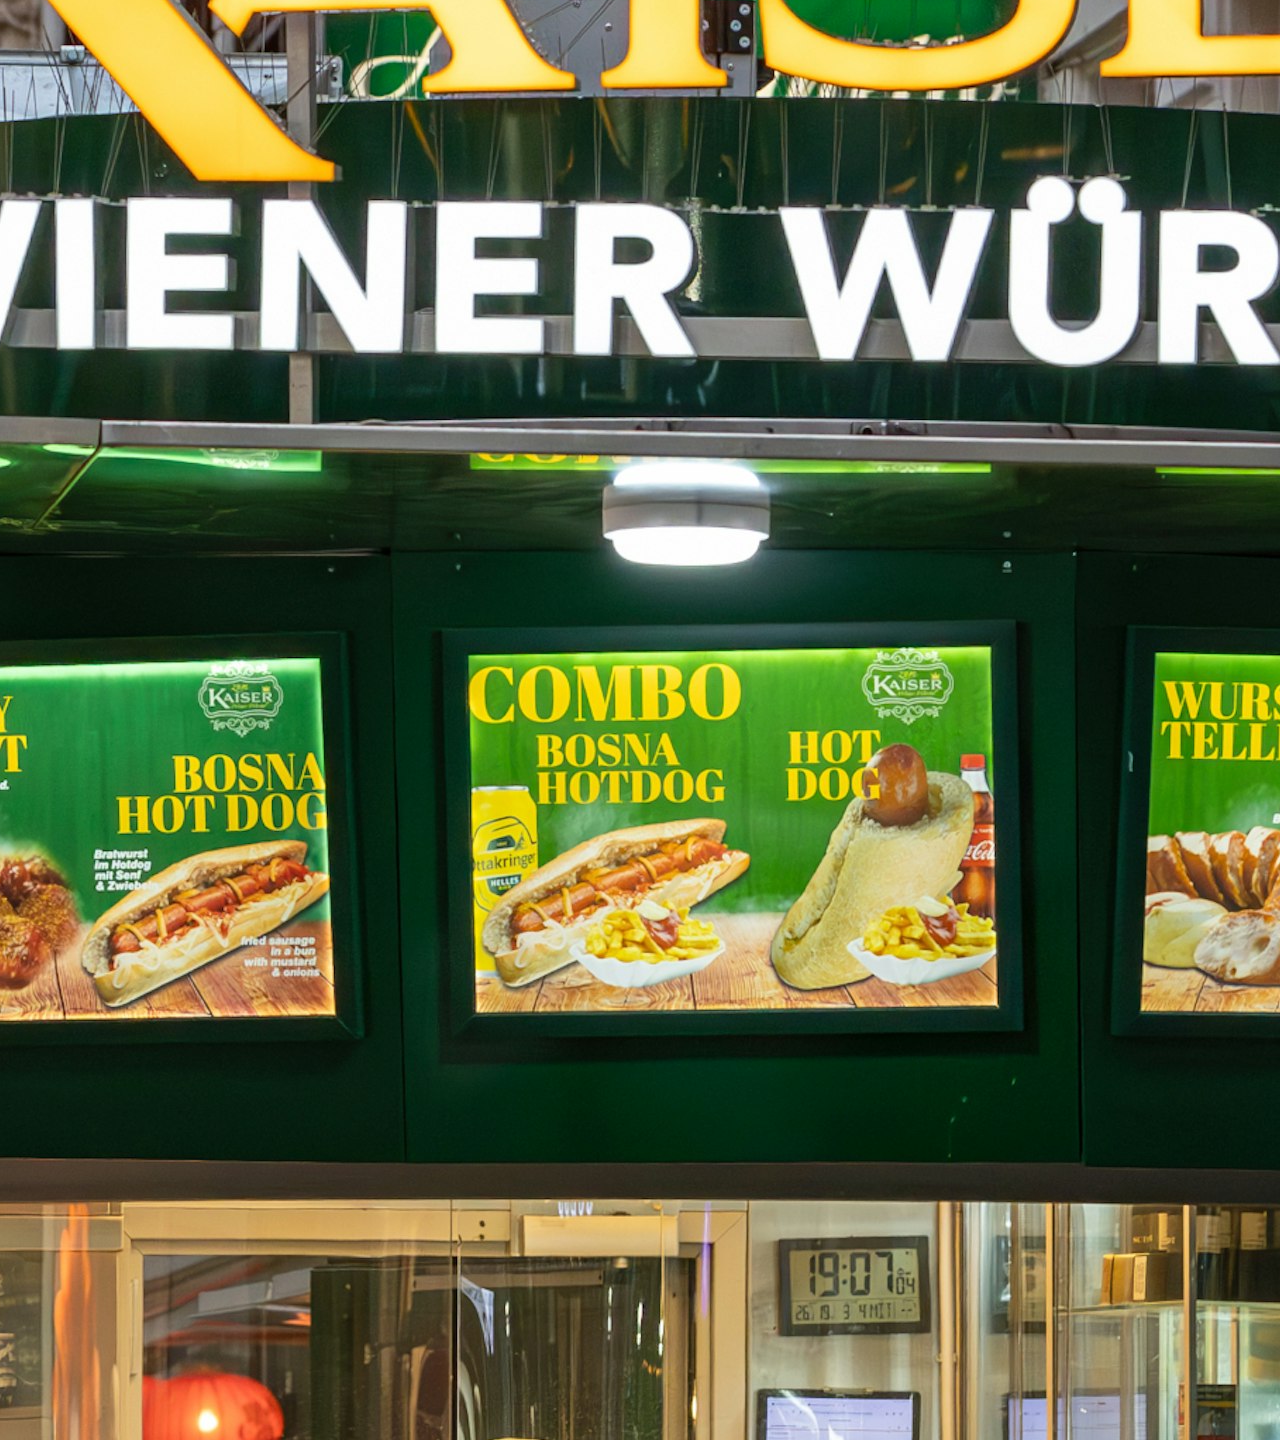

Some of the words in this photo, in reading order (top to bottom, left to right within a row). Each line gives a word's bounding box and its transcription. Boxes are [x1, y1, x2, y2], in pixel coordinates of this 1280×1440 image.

[208, 687, 273, 709] KAISER
[468, 662, 743, 725] COMBO
[873, 674, 943, 697] KAISER
[536, 732, 681, 768] BOSNA
[787, 730, 882, 766] HOT
[172, 752, 325, 794] BOSNA
[537, 768, 726, 806] HOTDOG
[785, 766, 882, 802] DOG
[116, 794, 216, 835] HOT
[226, 792, 327, 833] DOG
[94, 849, 148, 859] Bratwurst
[112, 859, 152, 871] Hotdog
[95, 870, 114, 880] mit
[116, 870, 142, 880] Senf
[269, 937, 316, 947] sausage
[294, 946, 316, 956] bun
[244, 957, 268, 967] with
[271, 956, 317, 967] mustard
[809, 1251, 894, 1298] 19:07
